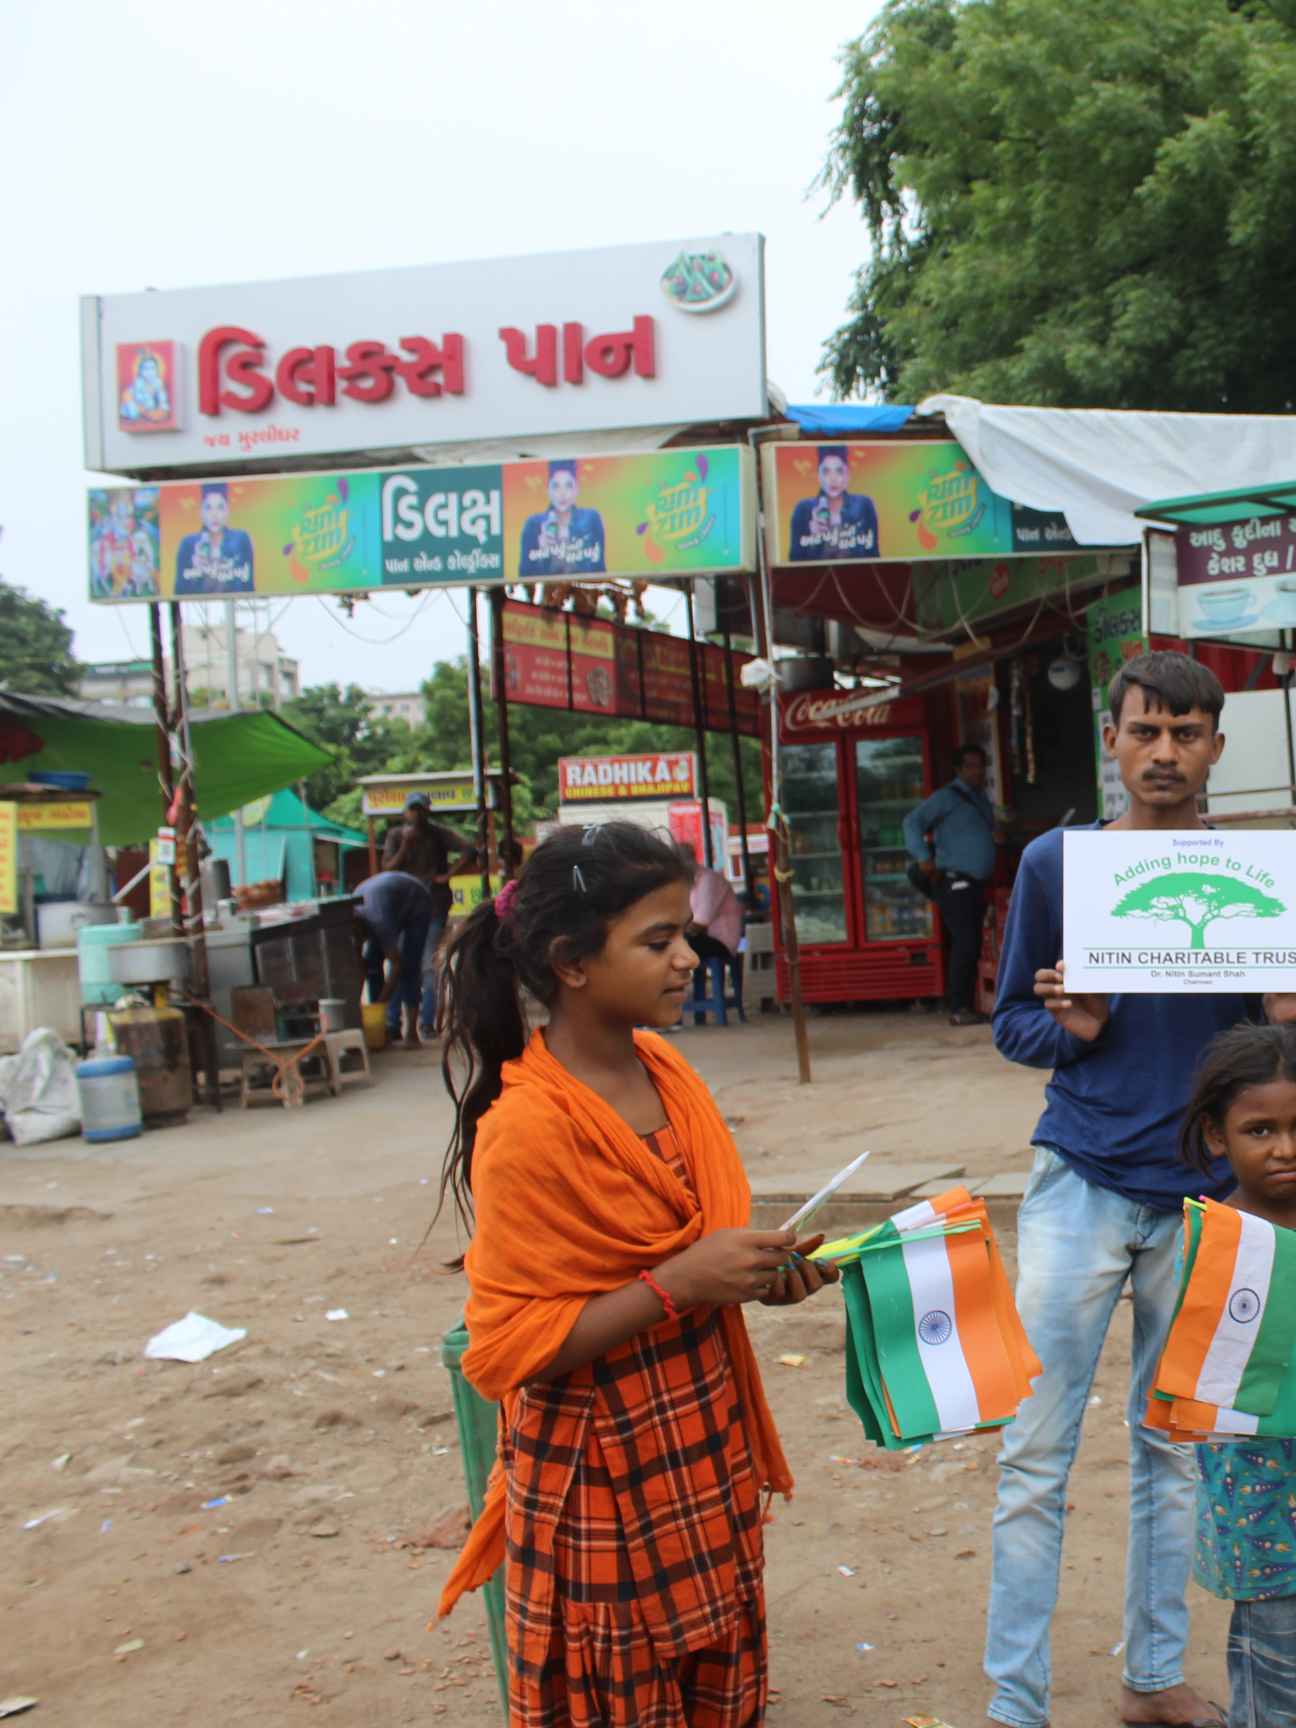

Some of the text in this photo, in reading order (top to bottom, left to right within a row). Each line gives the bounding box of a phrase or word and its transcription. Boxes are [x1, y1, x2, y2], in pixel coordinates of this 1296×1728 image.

[498, 314, 657, 388] પાન
[385, 557, 410, 574] પાન
[566, 759, 672, 786] RADHIKA
[1172, 838, 1225, 849] Supported By
[1112, 852, 1275, 888] Adding hope to Life
[1088, 951, 1133, 965] NITIN
[1137, 951, 1247, 965] CHARITABLE
[1150, 969, 1246, 978] Dr. Nitin Sumant Shah
